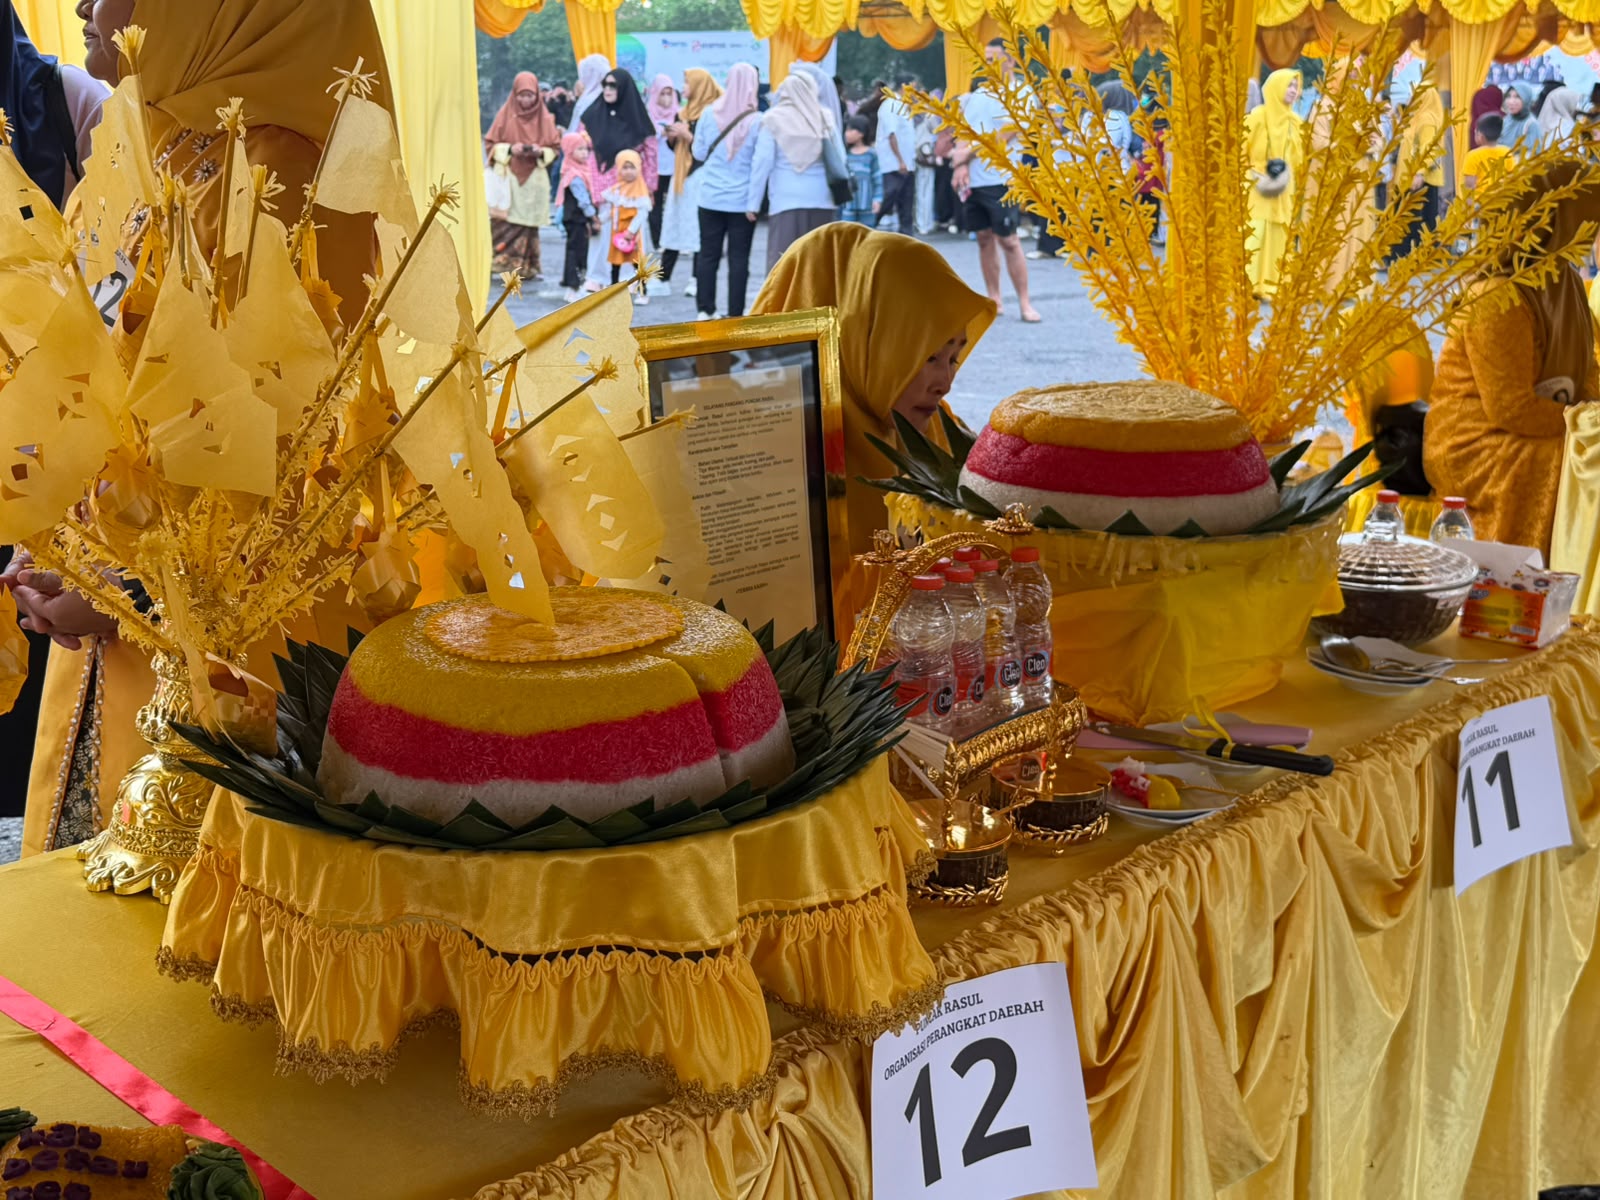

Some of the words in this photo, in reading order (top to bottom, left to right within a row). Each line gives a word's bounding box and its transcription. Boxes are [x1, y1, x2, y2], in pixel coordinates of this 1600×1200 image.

[1028, 657, 1045, 672] Cleo
[1475, 723, 1499, 738] RASUL
[1501, 727, 1536, 746] DAERAH
[1461, 750, 1520, 849] 11
[944, 993, 984, 1014] RASUL
[883, 1040, 927, 1081] ORGANISASI
[926, 1012, 987, 1049] PERANGKAT
[989, 1000, 1045, 1024] DAERAH
[904, 1036, 1032, 1188] 12
